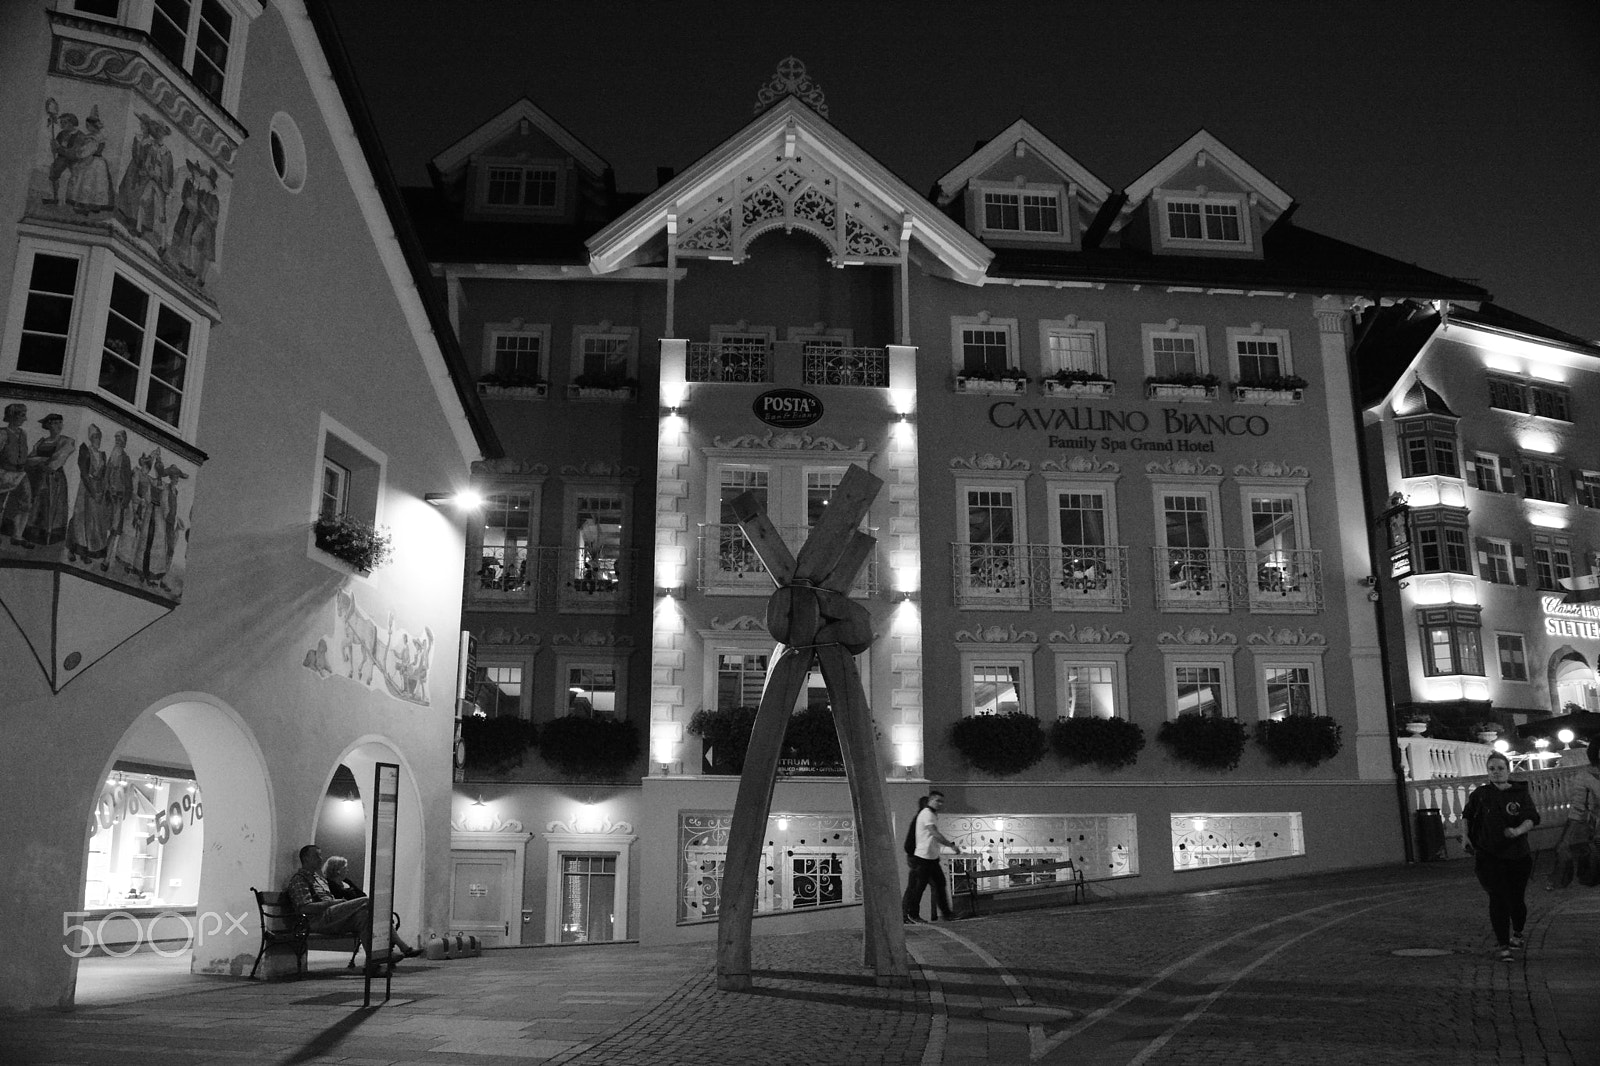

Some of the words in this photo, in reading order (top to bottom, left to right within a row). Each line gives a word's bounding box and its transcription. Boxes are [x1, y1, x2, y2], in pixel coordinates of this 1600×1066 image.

[988, 401, 1149, 432] CAVALLINO
[1162, 408, 1270, 436] BIANCO
[1048, 436, 1096, 452] Family
[1101, 438, 1127, 453] Spa
[1130, 438, 1173, 452] Grand
[1177, 440, 1215, 453] Hotel
[1583, 605, 1600, 618] HO
[1548, 618, 1600, 637] STETTE
